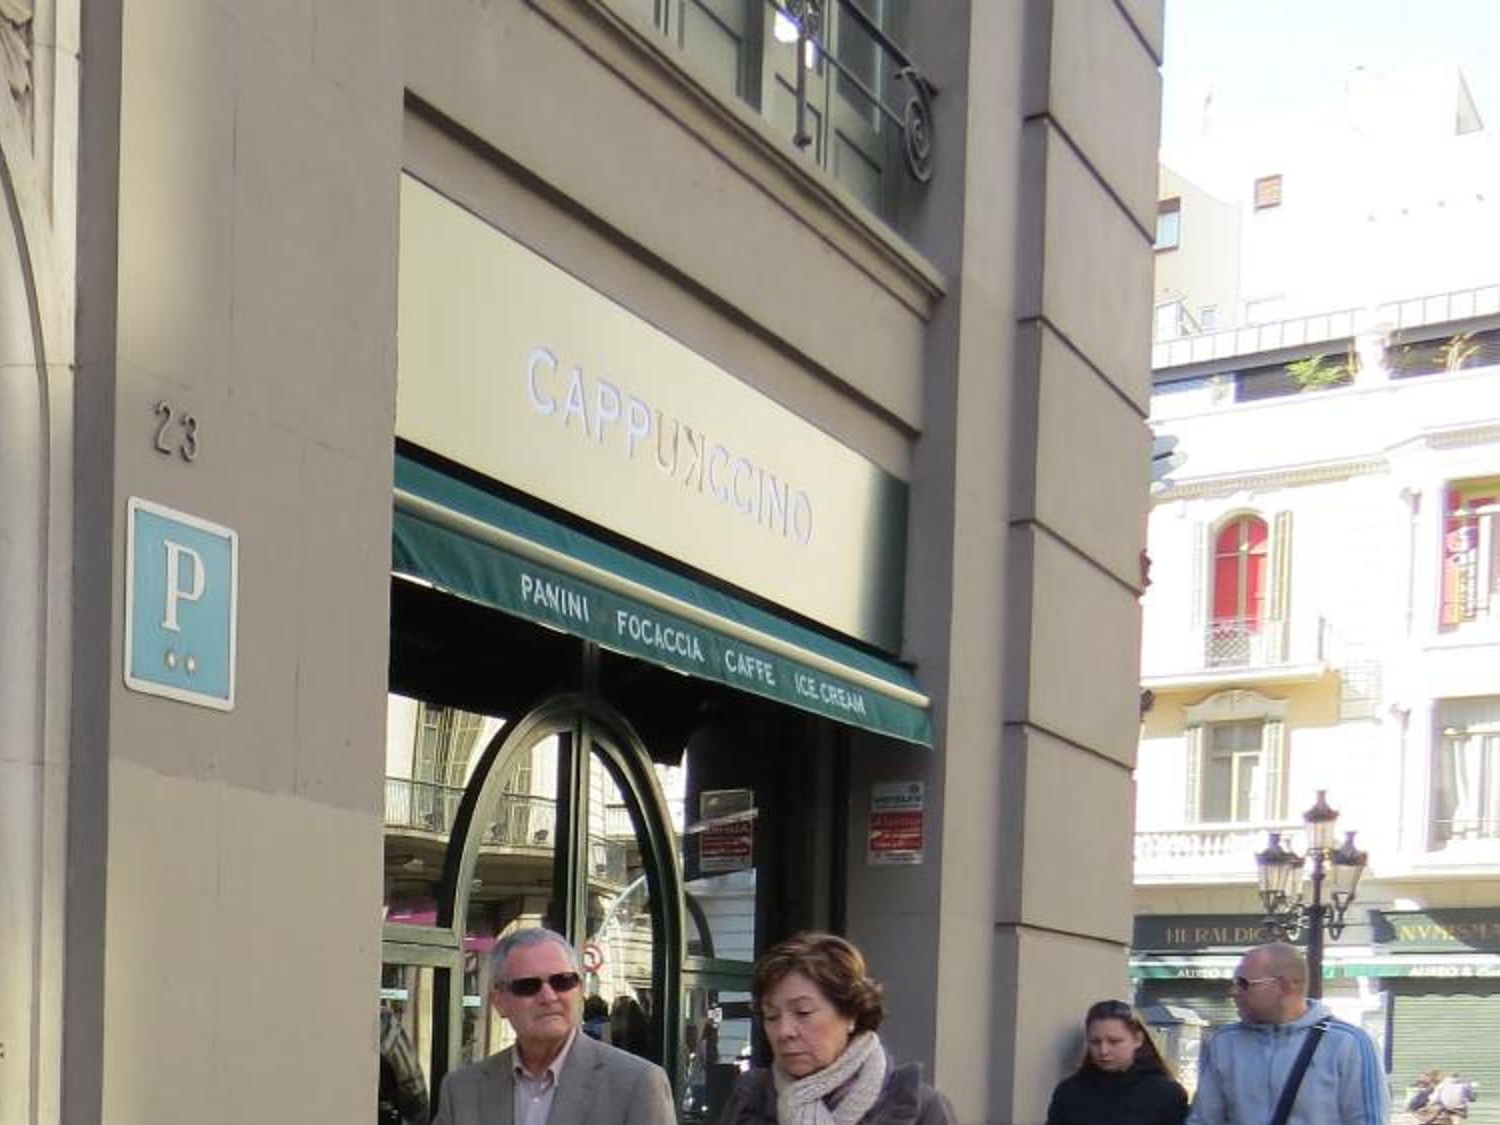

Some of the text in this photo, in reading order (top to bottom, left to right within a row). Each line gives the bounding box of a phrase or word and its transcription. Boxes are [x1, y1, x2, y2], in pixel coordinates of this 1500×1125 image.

[154, 401, 198, 463] 23
[162, 539, 206, 632] P
[521, 573, 867, 717] PANINI FOCACCIA CAFFE ICE CREAM
